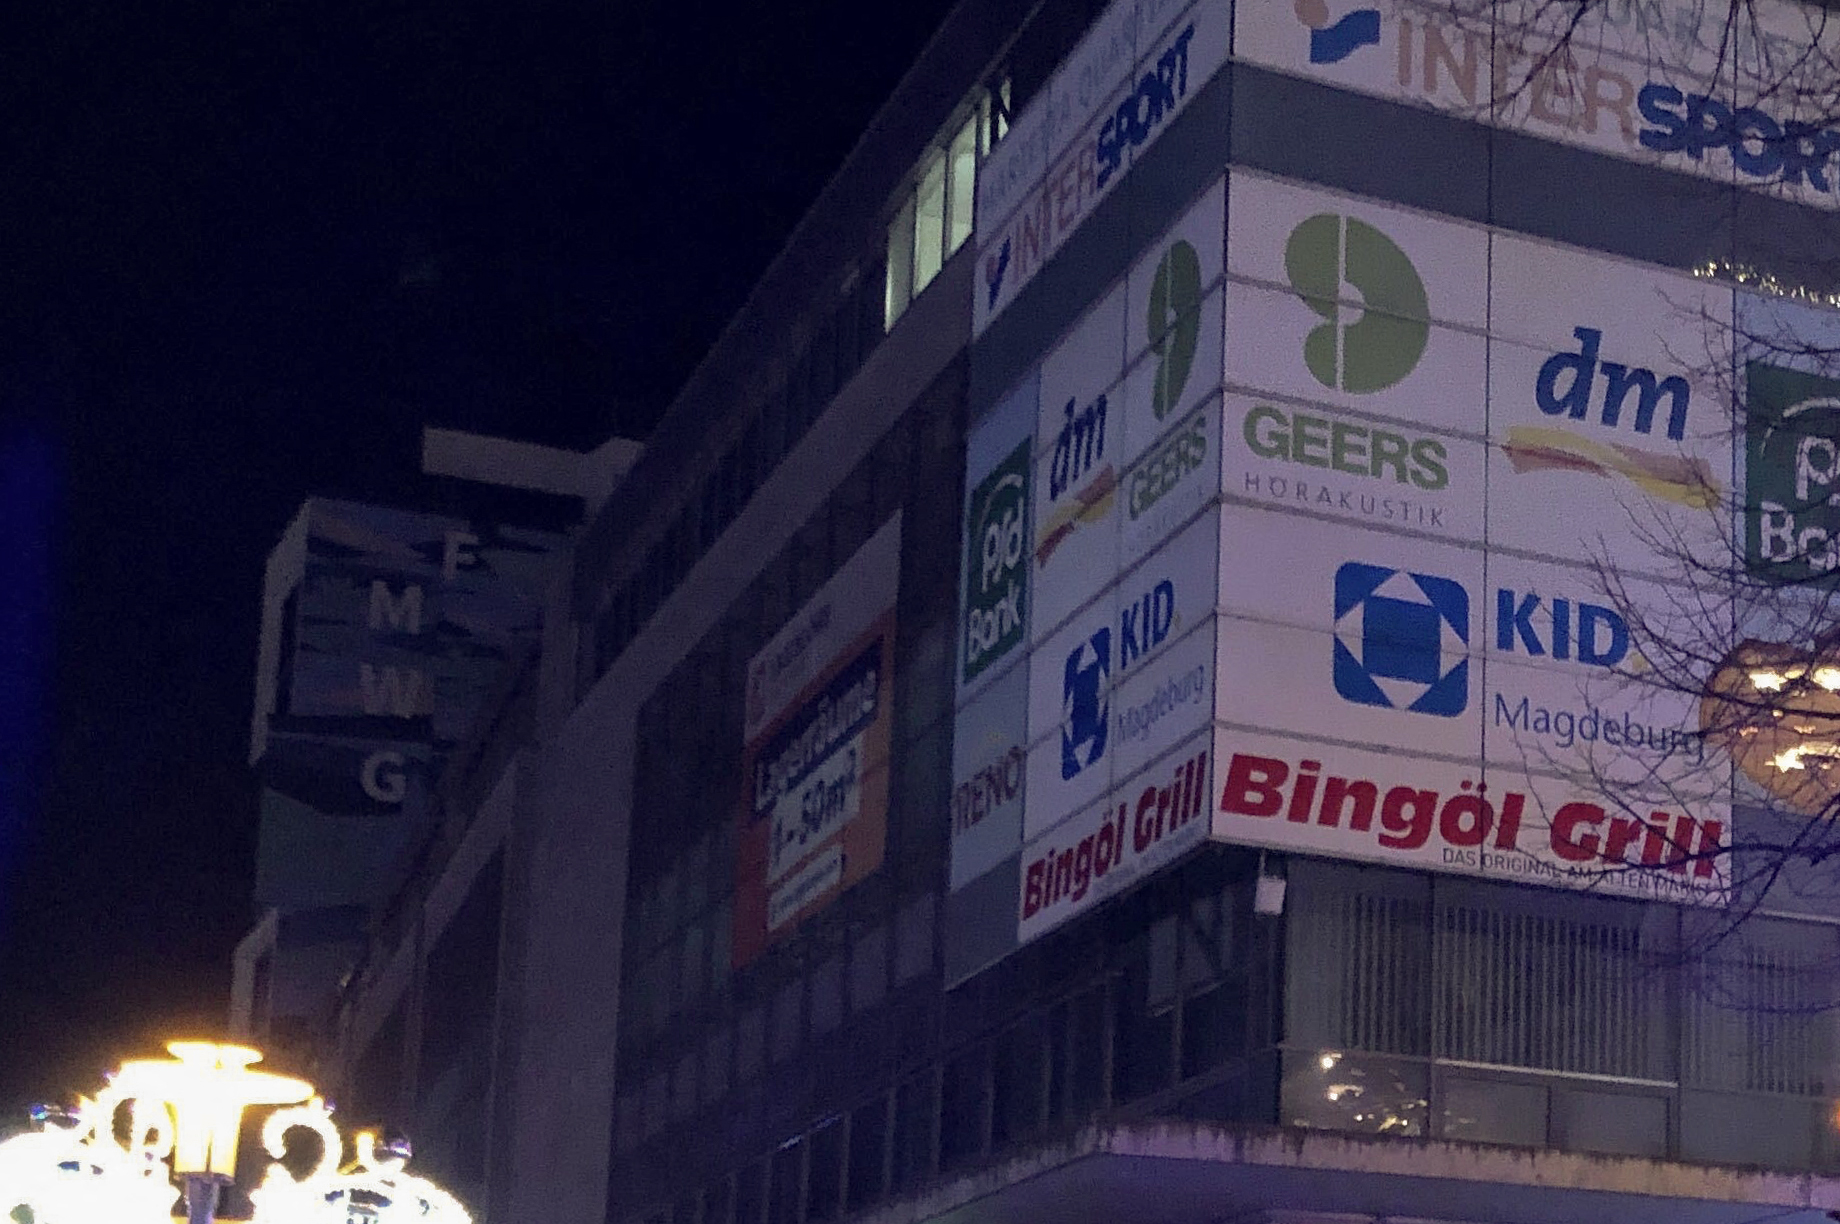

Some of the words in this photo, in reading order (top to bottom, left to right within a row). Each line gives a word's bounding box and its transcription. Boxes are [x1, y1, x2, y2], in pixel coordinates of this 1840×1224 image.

[1012, 23, 1195, 286] INTERSPORT
[1535, 326, 1691, 442] dm
[1050, 394, 1107, 501] dm
[1129, 415, 1207, 521] GEERS
[1242, 405, 1449, 490] GEERS
[968, 579, 1021, 663] Bank
[1117, 664, 1205, 745] Magdeburg
[1494, 692, 1706, 765] Magdeburg
[1022, 801, 1128, 921] Bingöl
[1133, 751, 1207, 854] Grill
[1220, 753, 1525, 851] Bingöl
[1550, 800, 1723, 879] Grill
[1442, 847, 1476, 867] DAS
[1482, 854, 1563, 879] ORIGINAL
